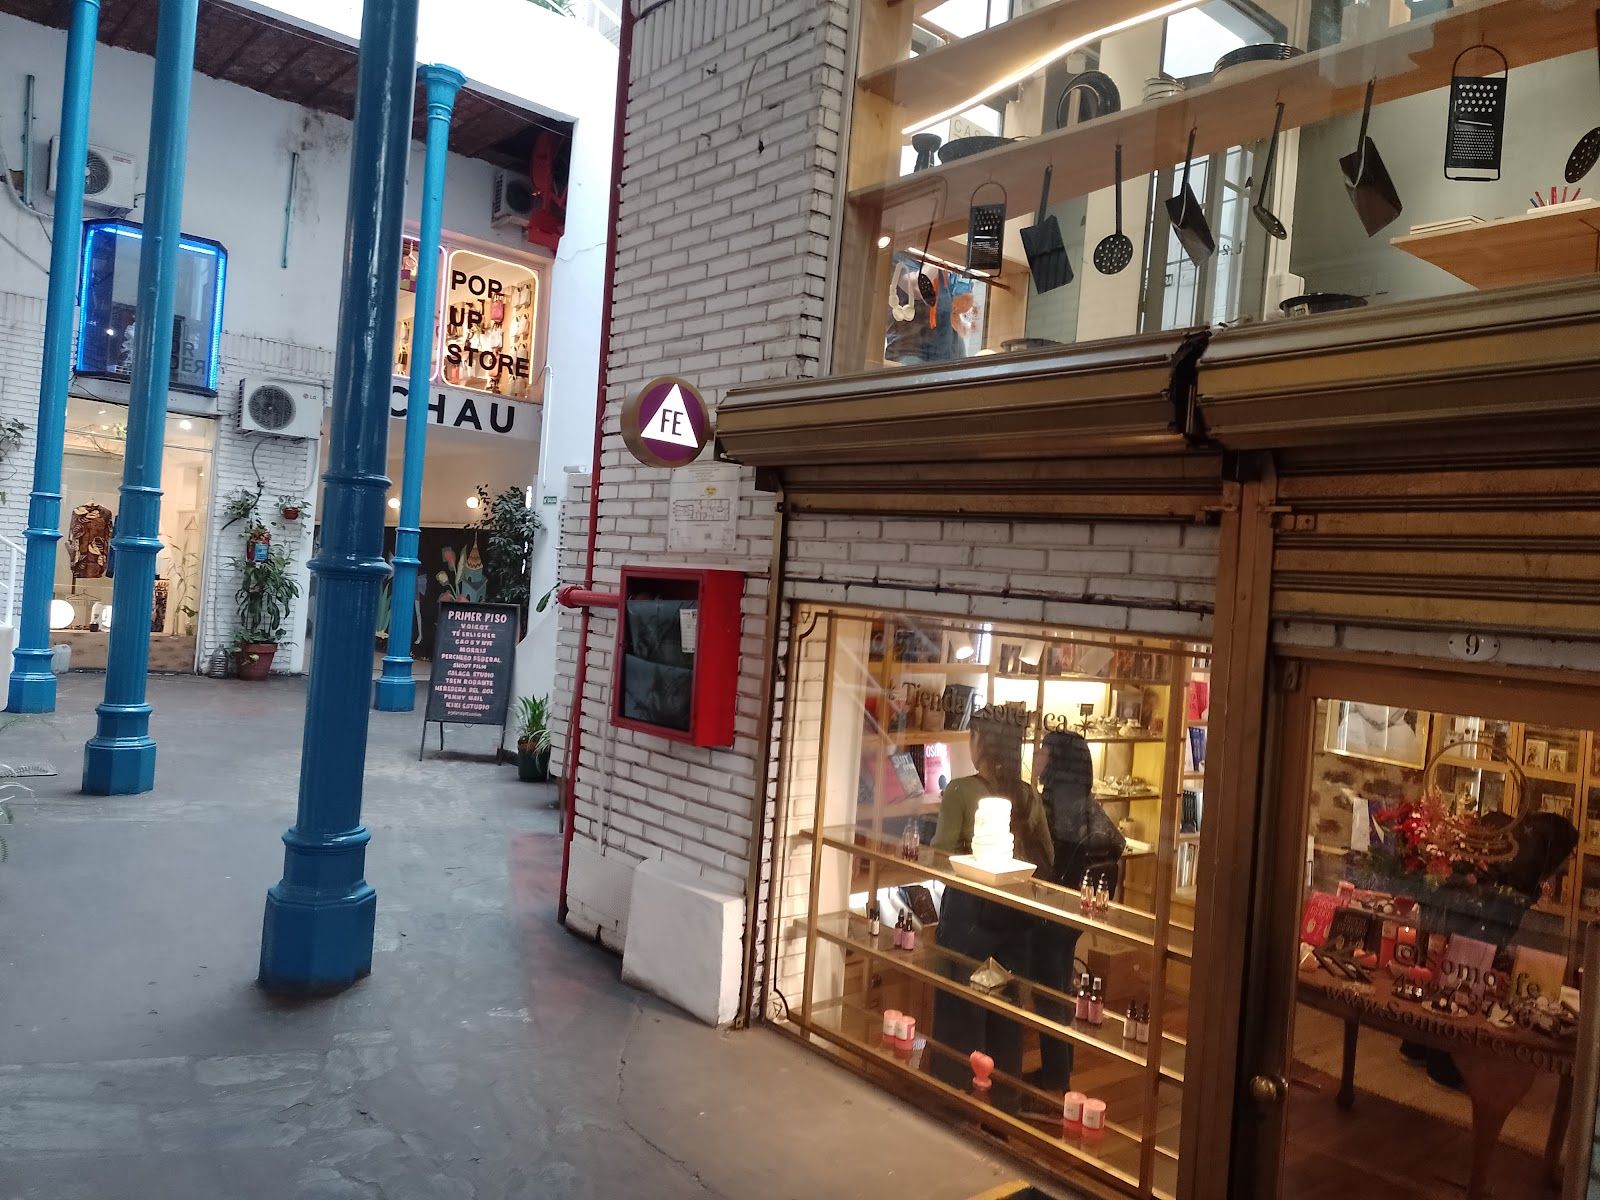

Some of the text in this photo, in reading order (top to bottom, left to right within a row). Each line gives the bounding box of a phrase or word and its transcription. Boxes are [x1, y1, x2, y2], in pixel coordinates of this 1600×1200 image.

[451, 270, 503, 298] POP
[449, 305, 483, 329] UP
[446, 343, 530, 378] STORE
[391, 385, 515, 433] CHAU
[660, 408, 684, 436] FE
[448, 610, 508, 624] PRIMER PISO
[1465, 631, 1480, 656] 9
[902, 681, 966, 714] Tienda
